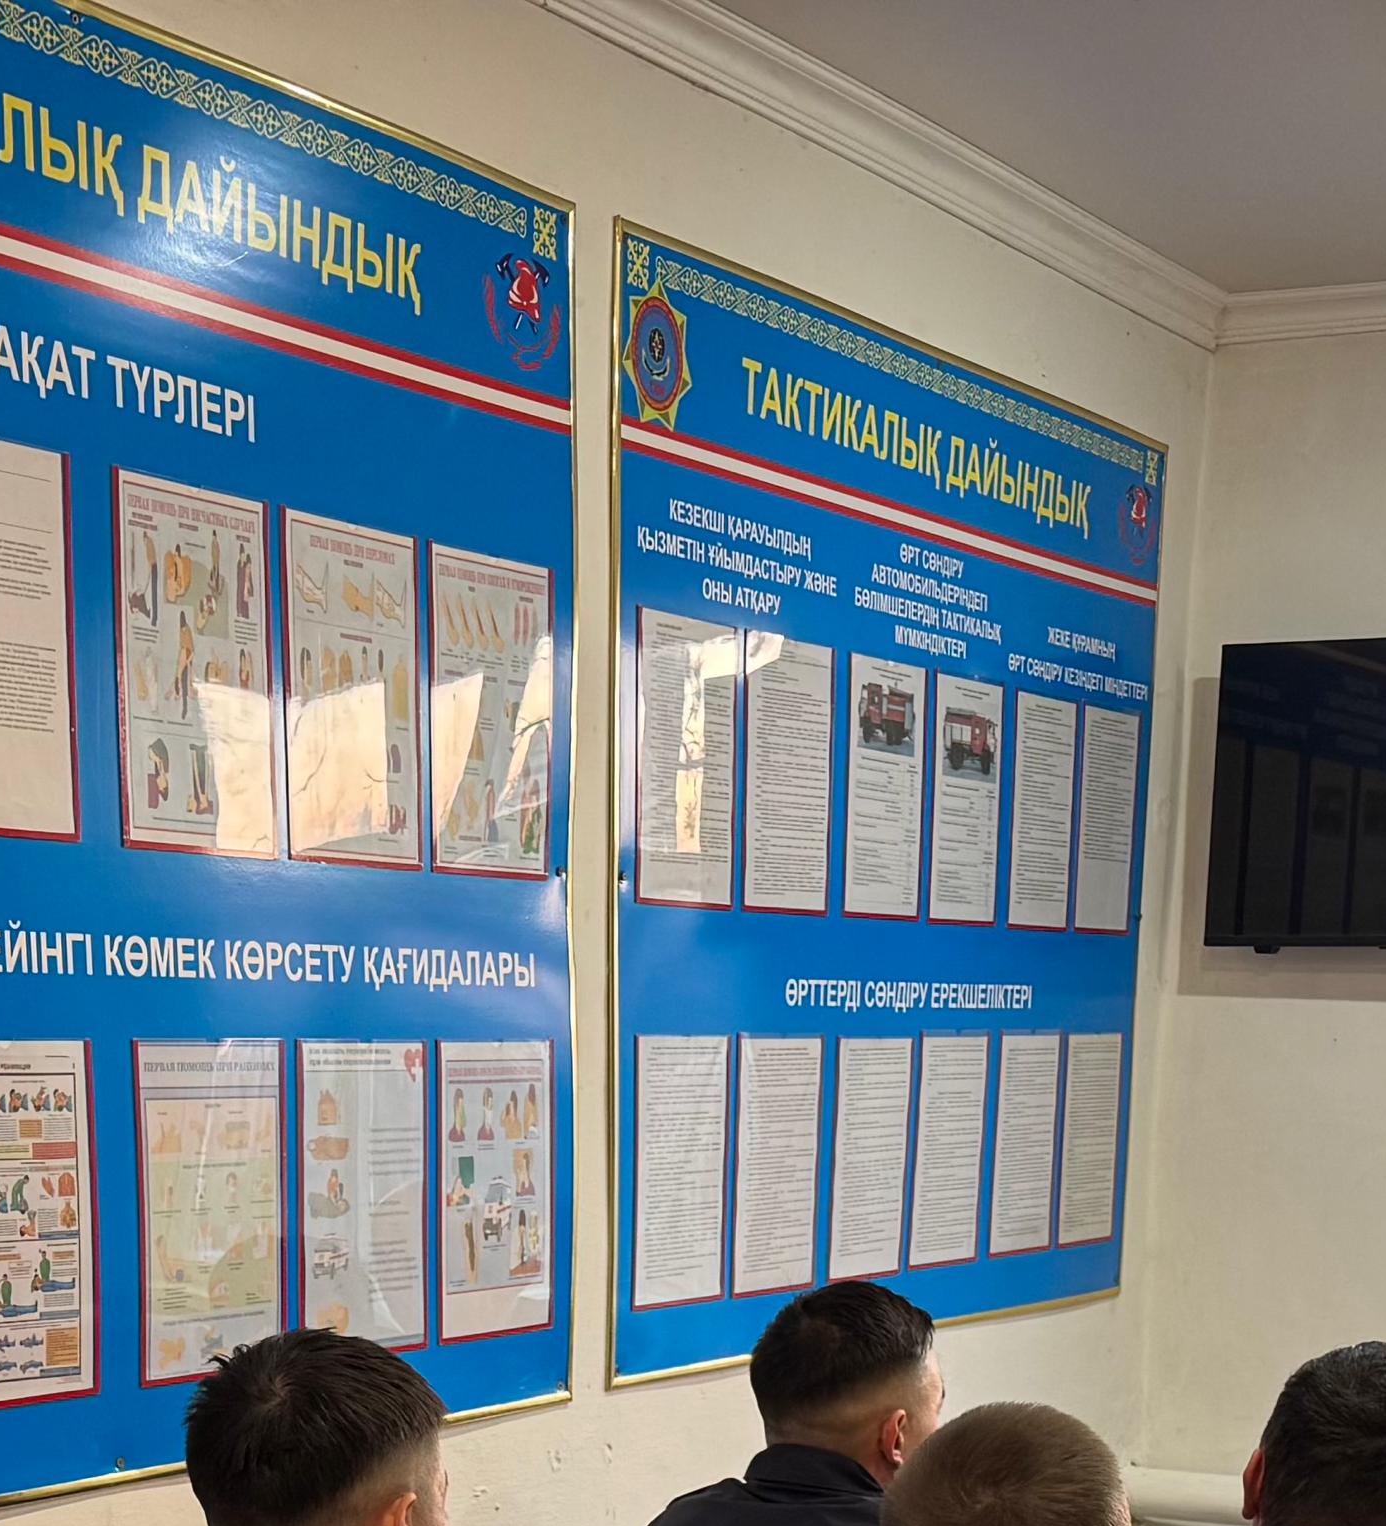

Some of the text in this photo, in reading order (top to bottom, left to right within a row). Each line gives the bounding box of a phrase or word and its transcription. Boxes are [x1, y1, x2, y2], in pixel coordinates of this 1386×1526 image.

[137, 146, 422, 316] ДАЙЫНДЫҚ
[106, 355, 256, 444] ТҮРЛЕРІ
[741, 356, 1092, 540] ТАКТИКАЛЫҚ ДАЙЫНДЫҚ
[669, 498, 812, 562] КЕЗЕКШІ ҚАРАУЫЛДЫҢ
[637, 525, 838, 597] ҚЫЗМЕТІН ҰЙЫМДАСТЫРУ ЖӘНЕ
[871, 562, 988, 612] АВТОМОБИЛЬДЕРІНДЕГІ
[899, 543, 964, 579] ӨРТ СӨНДІРУ
[702, 577, 781, 616] ОНЫ АТҚАРУ
[854, 586, 1002, 646] БӨЛІМШЕЛЕРДІҢ ТАКТИКАЛЫҚ
[894, 624, 967, 660] МҮМКІНДІКТЕРІ
[1047, 626, 1072, 649] ЖЕКЕ
[1008, 653, 1026, 673] ӨРТ
[1026, 657, 1063, 683] СӨНДІРУ
[104, 934, 217, 980] КӨМЕК
[224, 939, 356, 983] КӨРСЕТУ
[363, 945, 536, 992] ҚАҒИДАЛАРЫ
[785, 978, 1033, 1014] ӨРТТЕРДІ СӨНДІРУ ЕРЕКШЕЛІКТЕРІ
